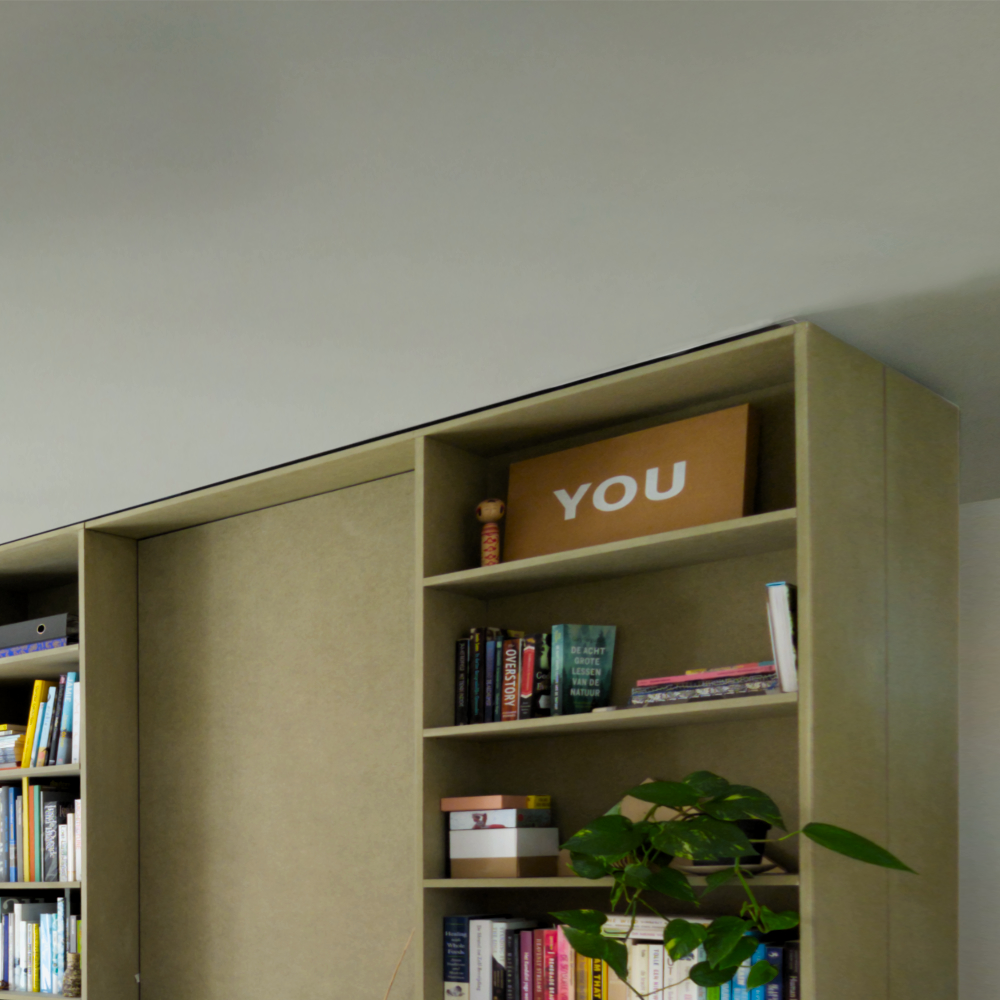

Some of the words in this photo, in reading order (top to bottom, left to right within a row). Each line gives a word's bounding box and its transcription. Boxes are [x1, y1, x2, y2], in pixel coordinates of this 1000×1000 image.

[553, 460, 687, 521] YOU
[571, 646, 582, 654] DE
[583, 646, 605, 655] ACHT
[574, 656, 600, 666] GROTE
[572, 667, 601, 676] LESSEN
[504, 649, 517, 707] OVERSTORY
[572, 678, 587, 686] VAN
[589, 678, 599, 686] DE
[65, 677, 73, 702] JAMIE
[570, 688, 600, 697] NATUUR
[560, 954, 568, 962] DE
[594, 958, 600, 972] AM
[789, 976, 797, 998] Human
